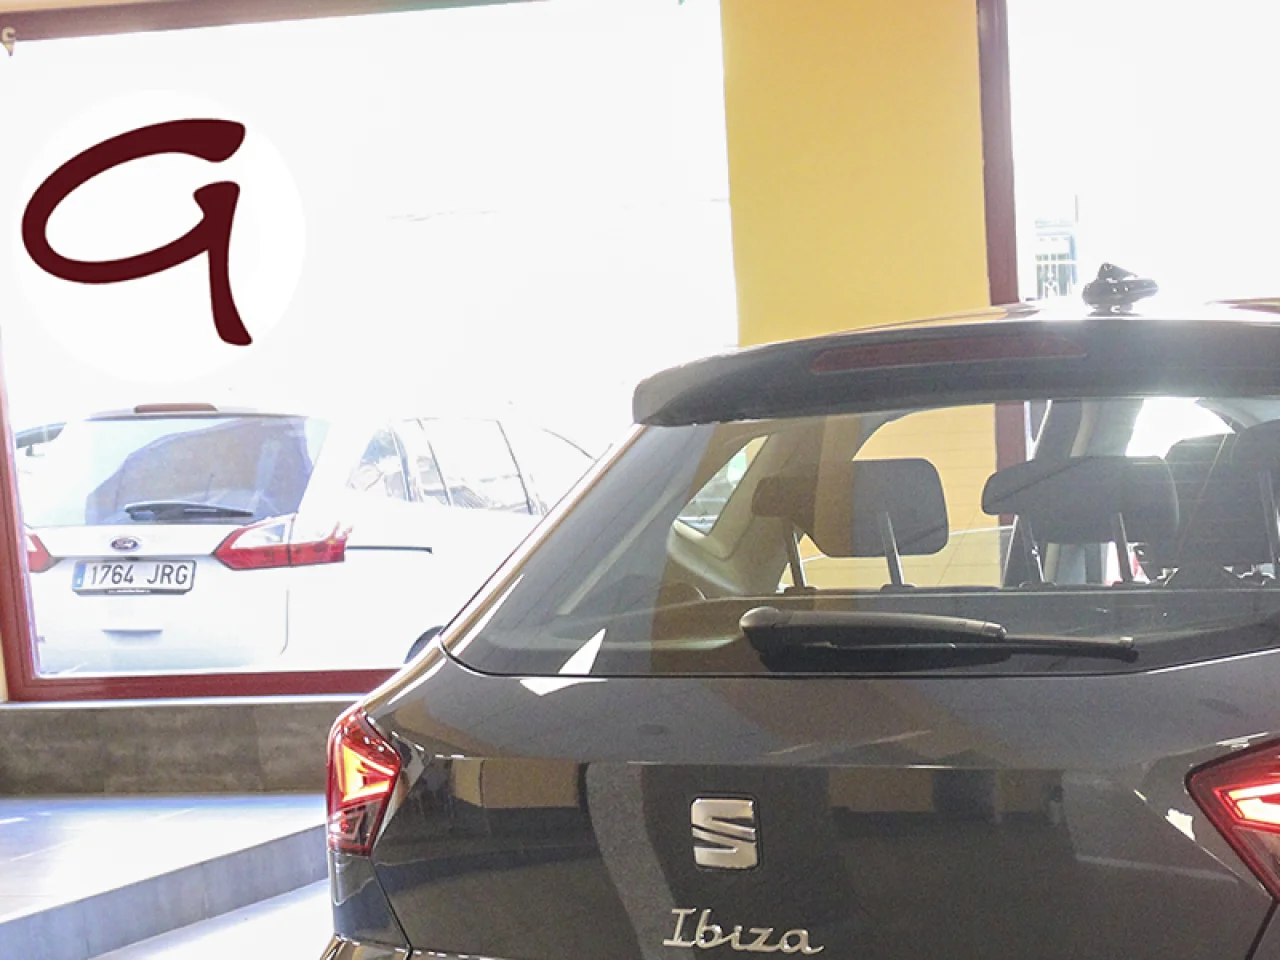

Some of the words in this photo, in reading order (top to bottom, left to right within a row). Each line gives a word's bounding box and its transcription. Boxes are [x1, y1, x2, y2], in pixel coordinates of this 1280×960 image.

[91, 564, 134, 585] 1764
[146, 564, 188, 585] JRG
[663, 908, 824, 955] Ibiza
